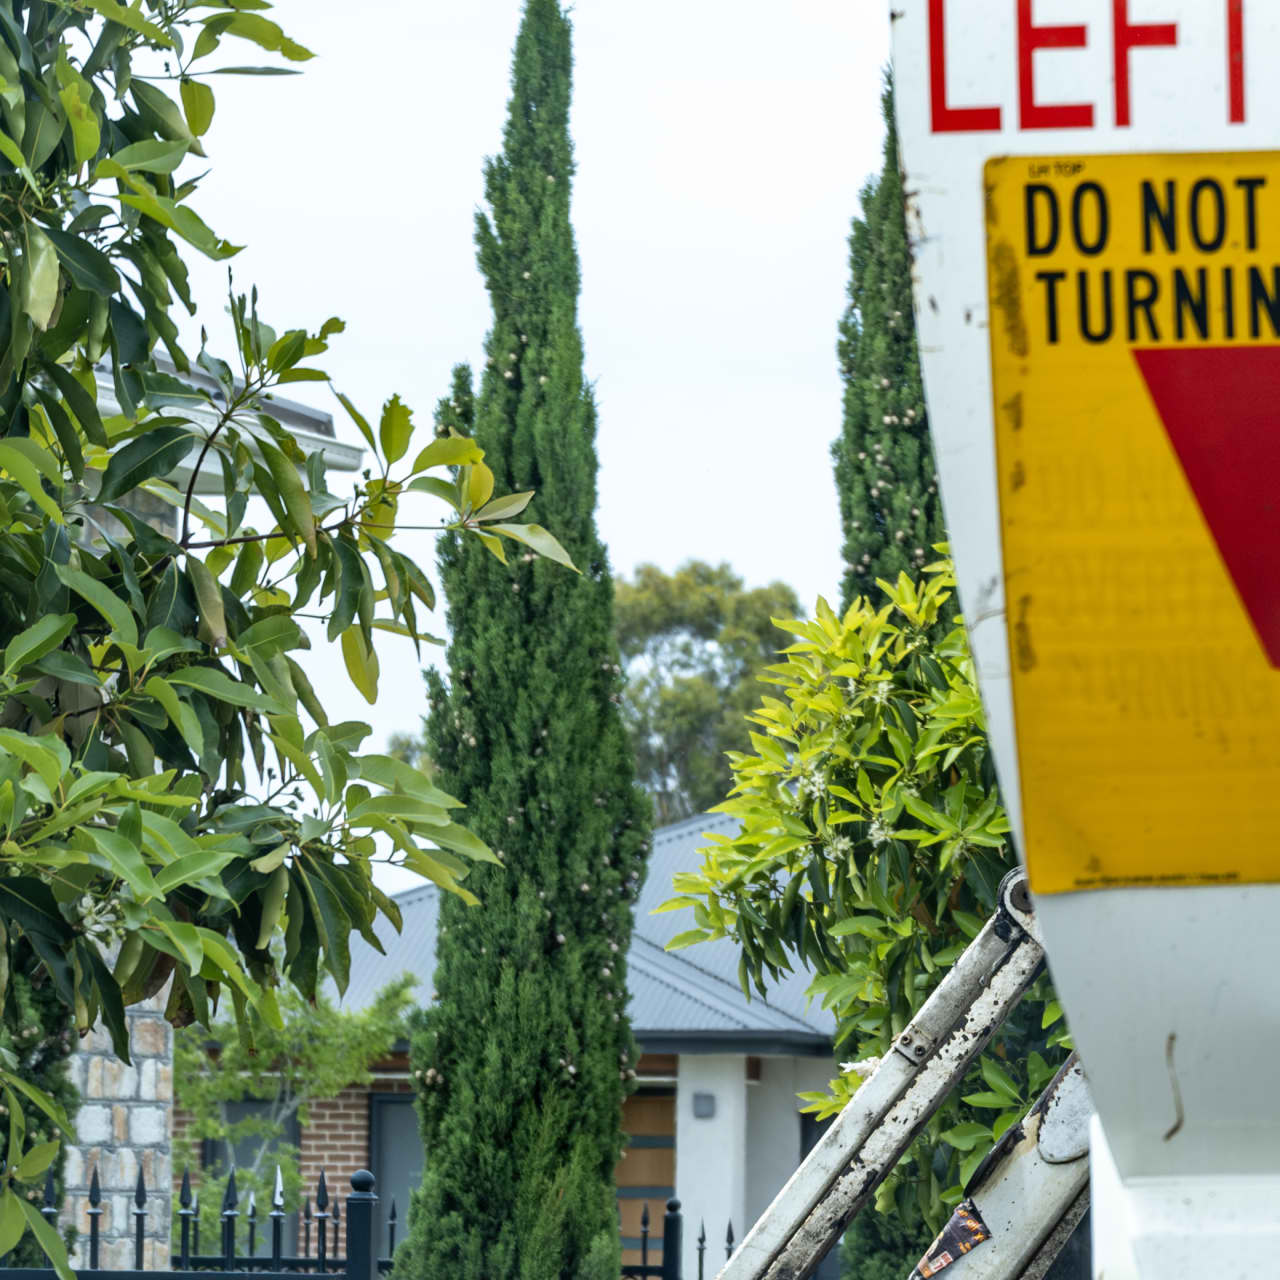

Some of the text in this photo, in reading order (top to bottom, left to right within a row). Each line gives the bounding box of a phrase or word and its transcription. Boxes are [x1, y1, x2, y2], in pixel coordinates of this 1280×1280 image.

[928, 0, 1245, 133] LEFT
[1025, 181, 1109, 257] DO
[1142, 177, 1266, 253] NOT
